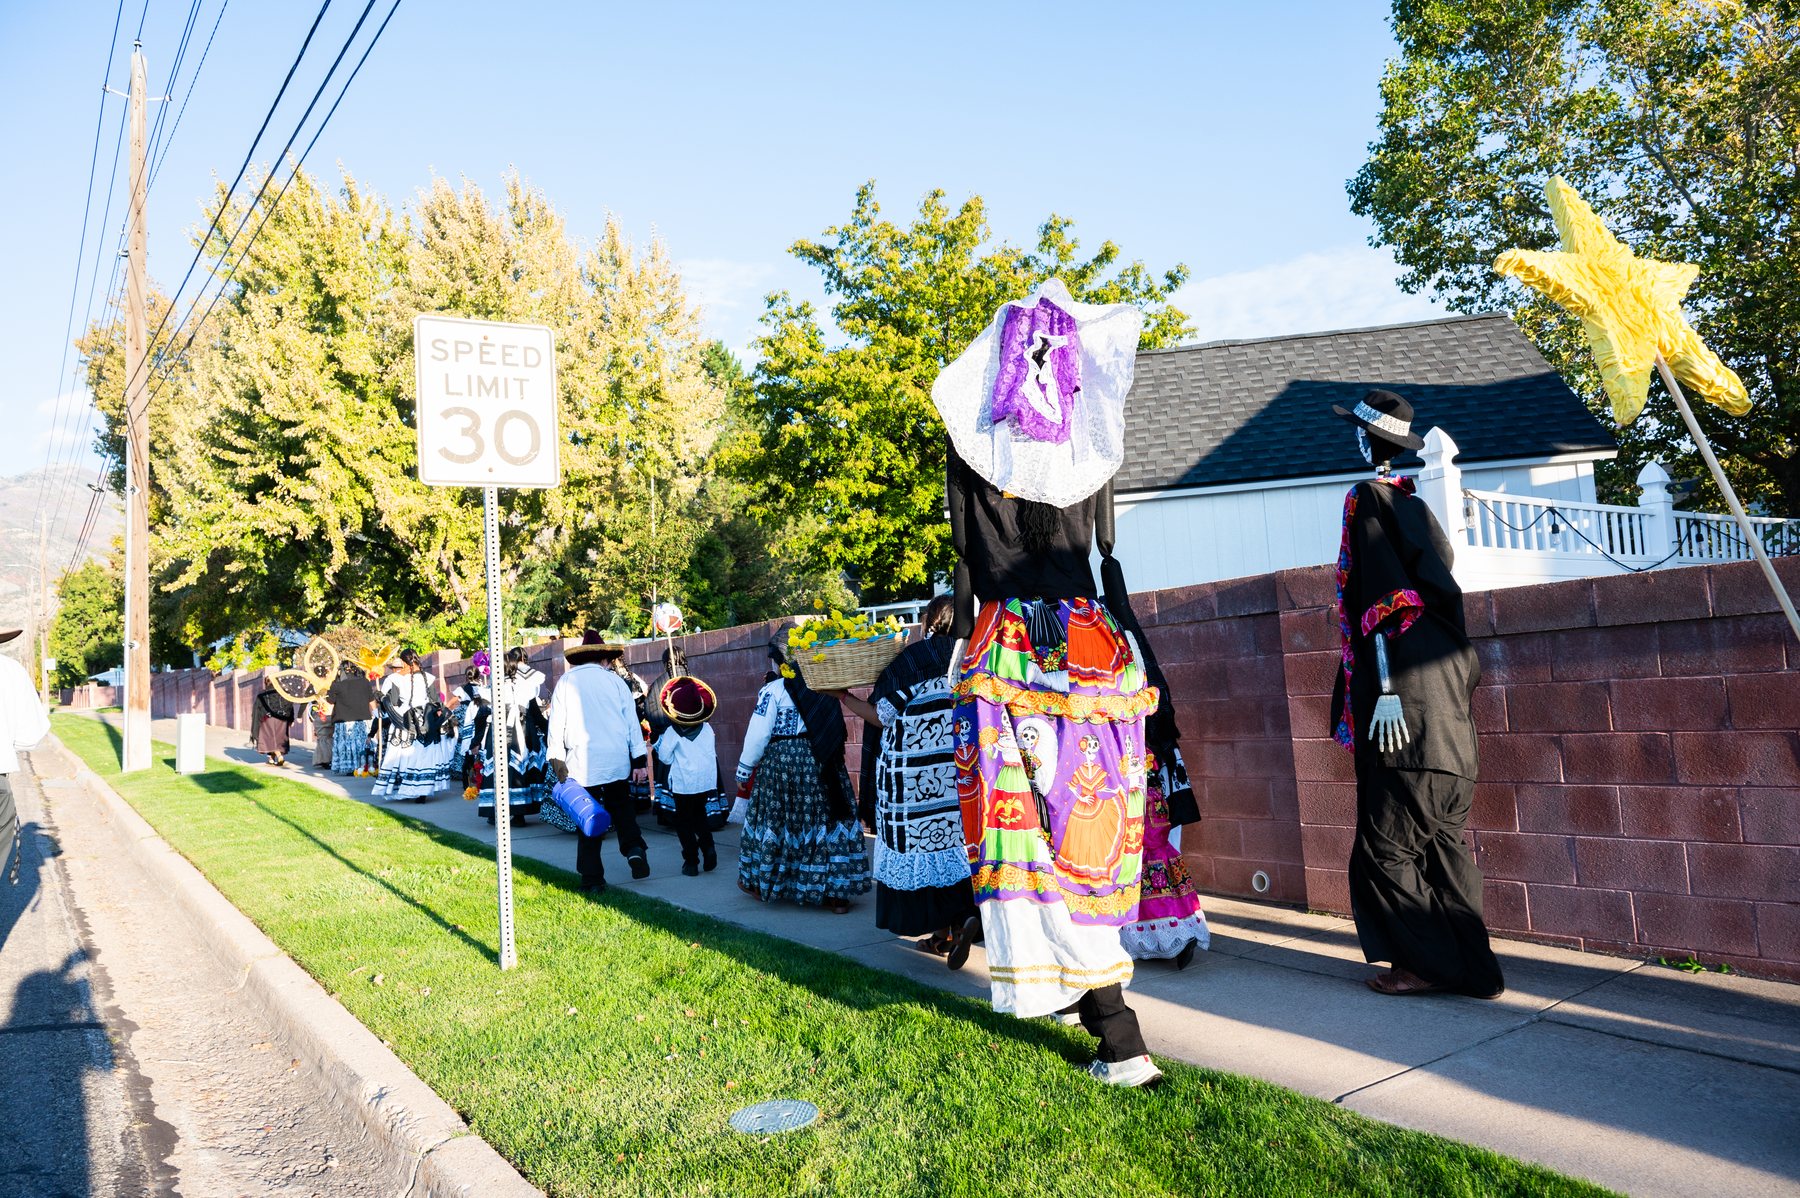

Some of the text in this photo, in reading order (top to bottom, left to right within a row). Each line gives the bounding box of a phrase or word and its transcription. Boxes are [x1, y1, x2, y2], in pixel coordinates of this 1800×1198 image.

[431, 338, 542, 369] SPEED
[444, 372, 530, 400] LIMIT
[438, 406, 542, 467] 30
